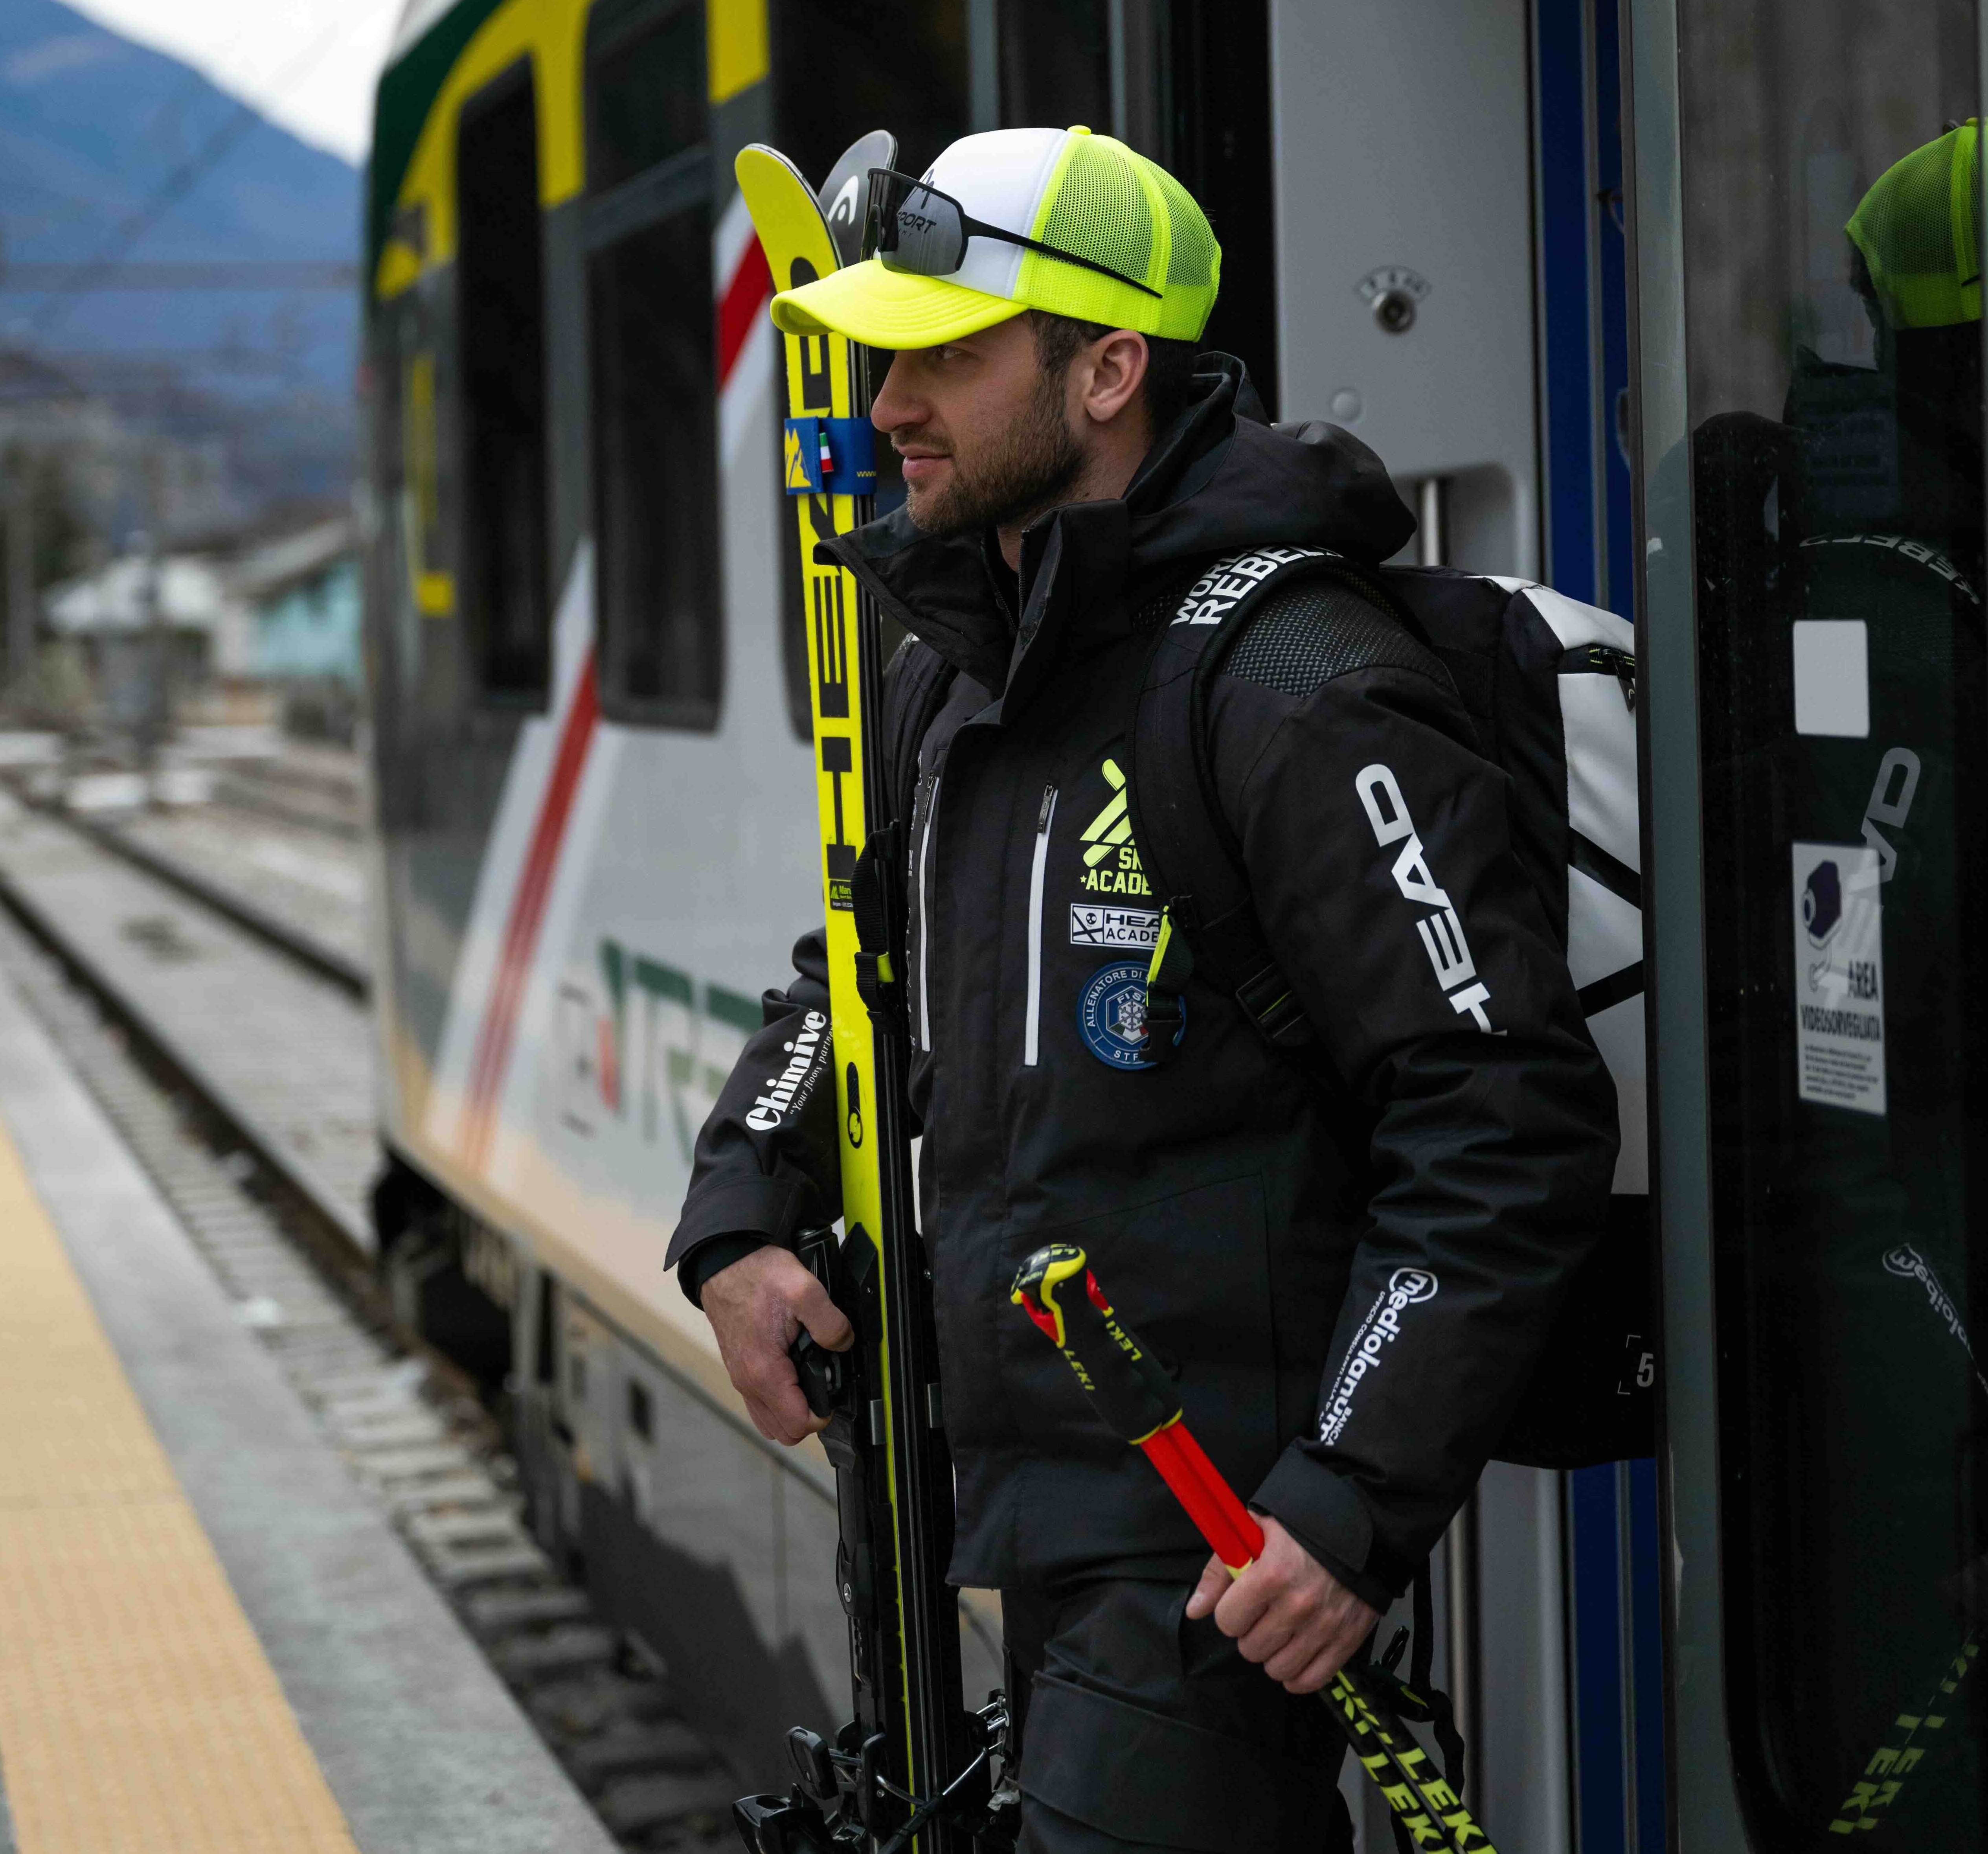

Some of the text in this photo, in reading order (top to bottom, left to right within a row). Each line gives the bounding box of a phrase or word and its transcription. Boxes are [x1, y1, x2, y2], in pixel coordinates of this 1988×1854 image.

[1169, 549, 1254, 627] WORL
[1355, 763, 1508, 1037] HEAD
[1086, 970, 1142, 1027] ALLENATORE DI
[803, 1066, 823, 1092] floors
[818, 1021, 832, 1065] partne
[1064, 1349, 1095, 1390] LEKI
[1106, 1321, 1143, 1361] LEKI
[1325, 1406, 1352, 1446] BANCA
